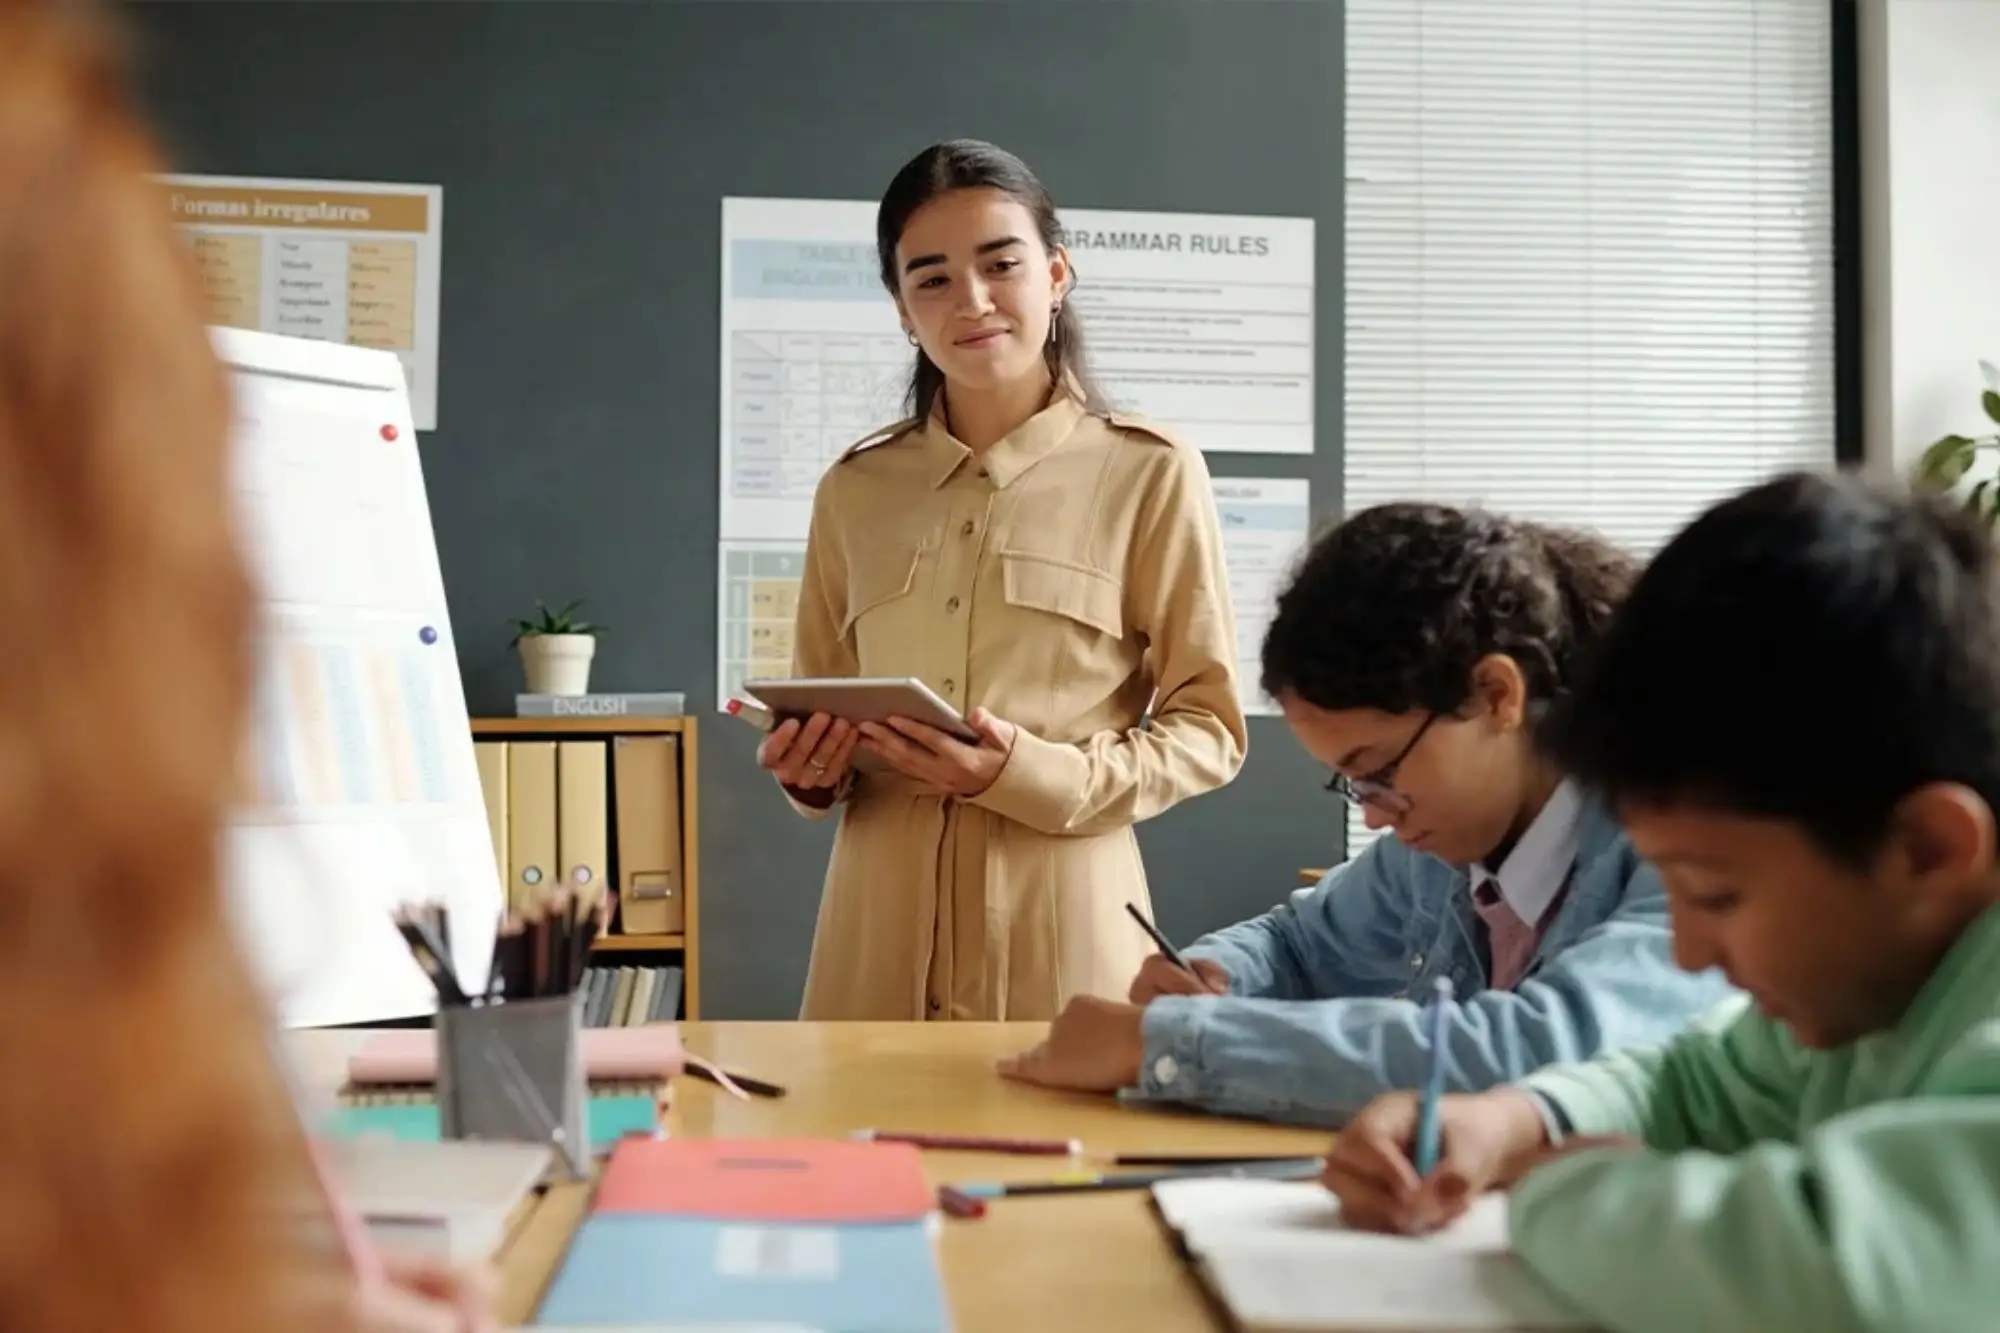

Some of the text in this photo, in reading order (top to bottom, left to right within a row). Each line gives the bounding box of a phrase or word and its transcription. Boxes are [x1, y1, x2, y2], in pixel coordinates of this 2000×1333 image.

[172, 194, 371, 223] Formas irregulares
[1190, 234, 1269, 256] RULES
[553, 699, 627, 715] ENGLISH
